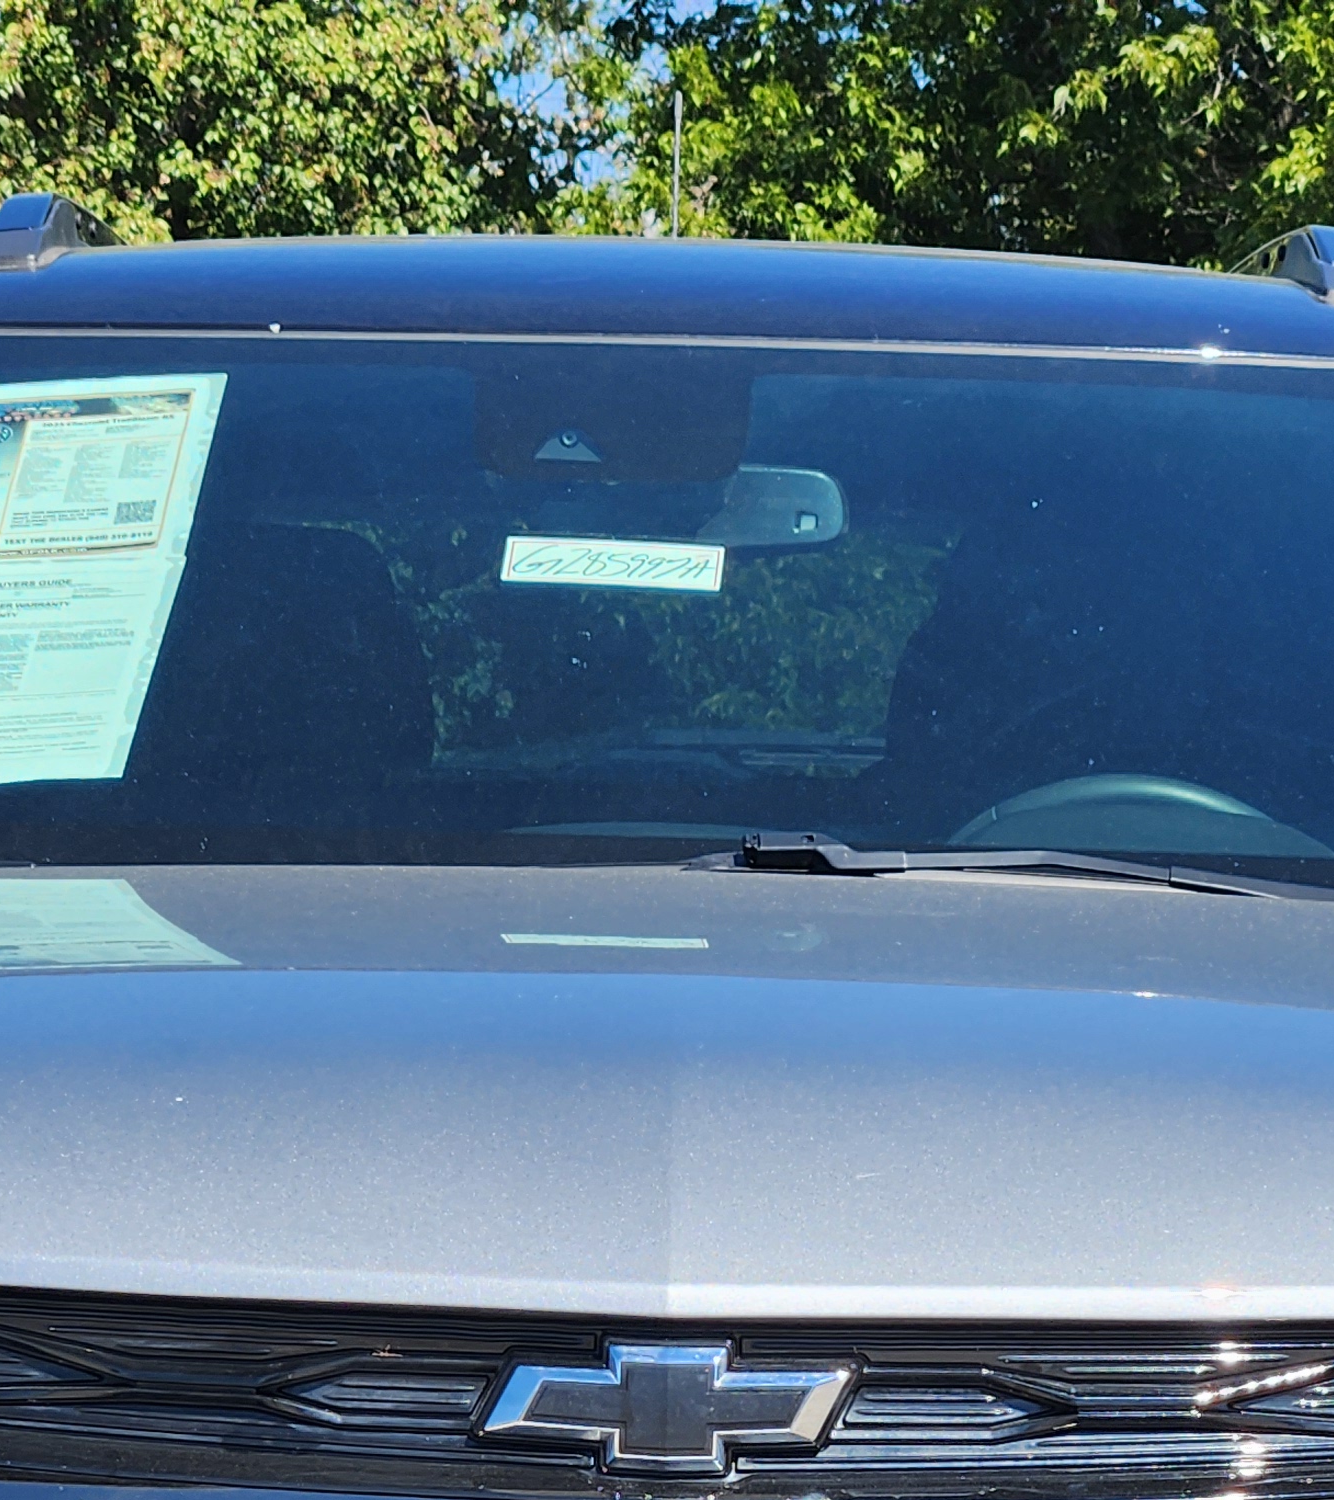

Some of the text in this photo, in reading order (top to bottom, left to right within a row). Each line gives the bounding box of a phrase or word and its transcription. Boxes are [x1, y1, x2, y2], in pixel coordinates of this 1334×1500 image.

[48, 535, 83, 543] DEALER
[38, 579, 72, 587] GUIDE
[15, 601, 70, 609] WARRANTY
